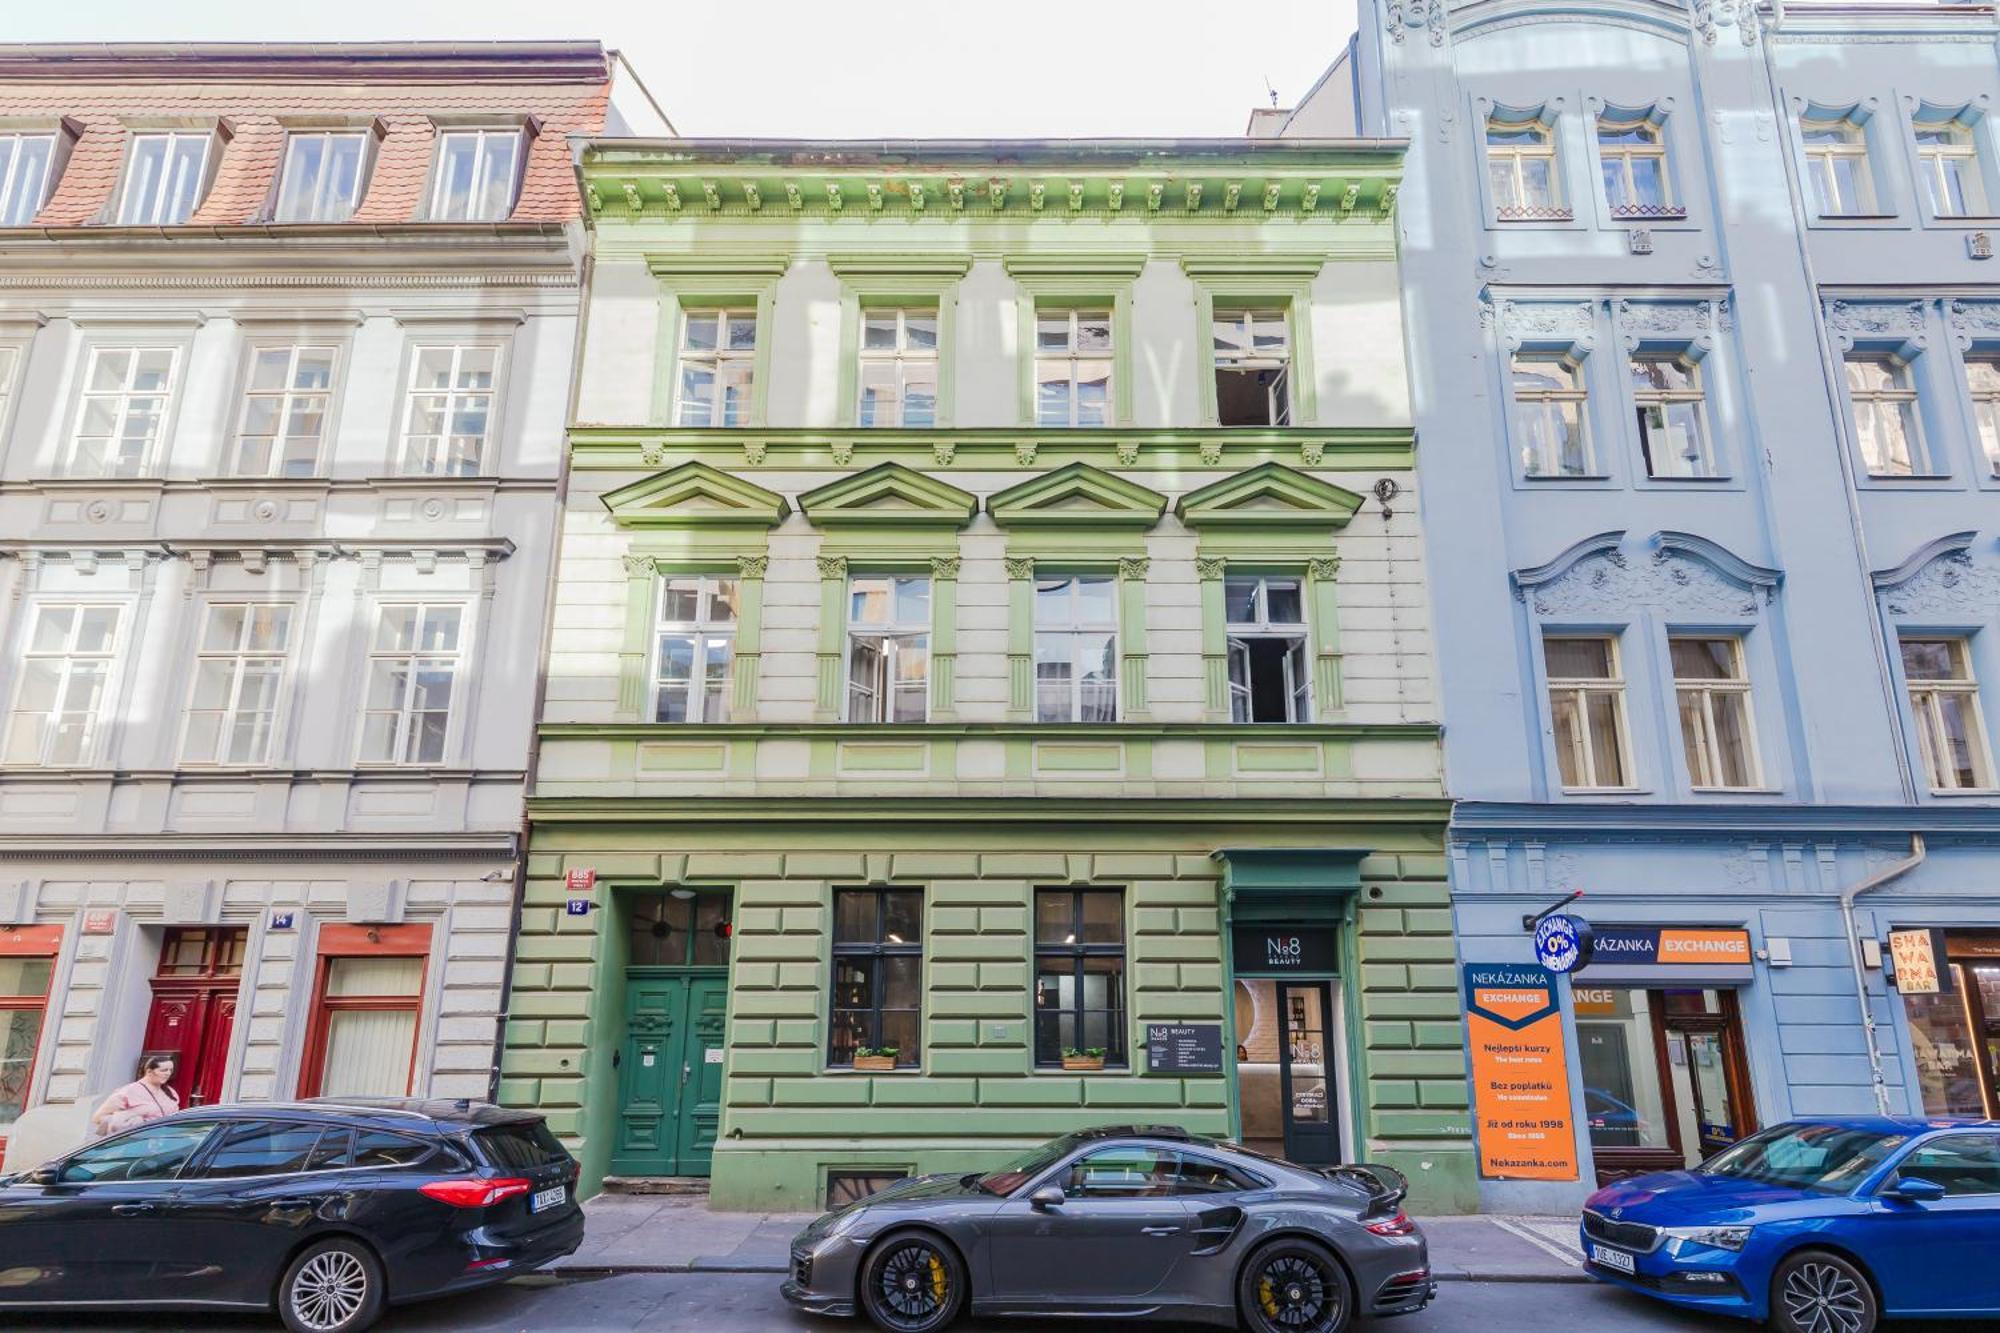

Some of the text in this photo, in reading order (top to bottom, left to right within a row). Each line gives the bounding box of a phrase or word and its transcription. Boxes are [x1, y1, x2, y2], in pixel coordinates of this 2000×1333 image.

[572, 902, 582, 912] 12
[1537, 916, 1574, 950] EXCHANGE
[1548, 934, 1569, 953] 0%
[1593, 938, 1745, 953] KÁZANKA EXCHANGE
[1472, 971, 1548, 985] NEKÁZANKA
[1907, 980, 1932, 991] BAR
[1482, 993, 1541, 1003] EXCHANGE
[1572, 990, 1614, 1004] ANGE
[1171, 1028, 1195, 1036] BEAUTY
[1524, 1044, 1552, 1054] kurzy
[1490, 1081, 1508, 1090] Bez
[1501, 1120, 1513, 1129] od
[1515, 1120, 1537, 1129] roku
[1539, 1120, 1564, 1129] 1998
[1490, 1159, 1568, 1168] Nekazanka.com
